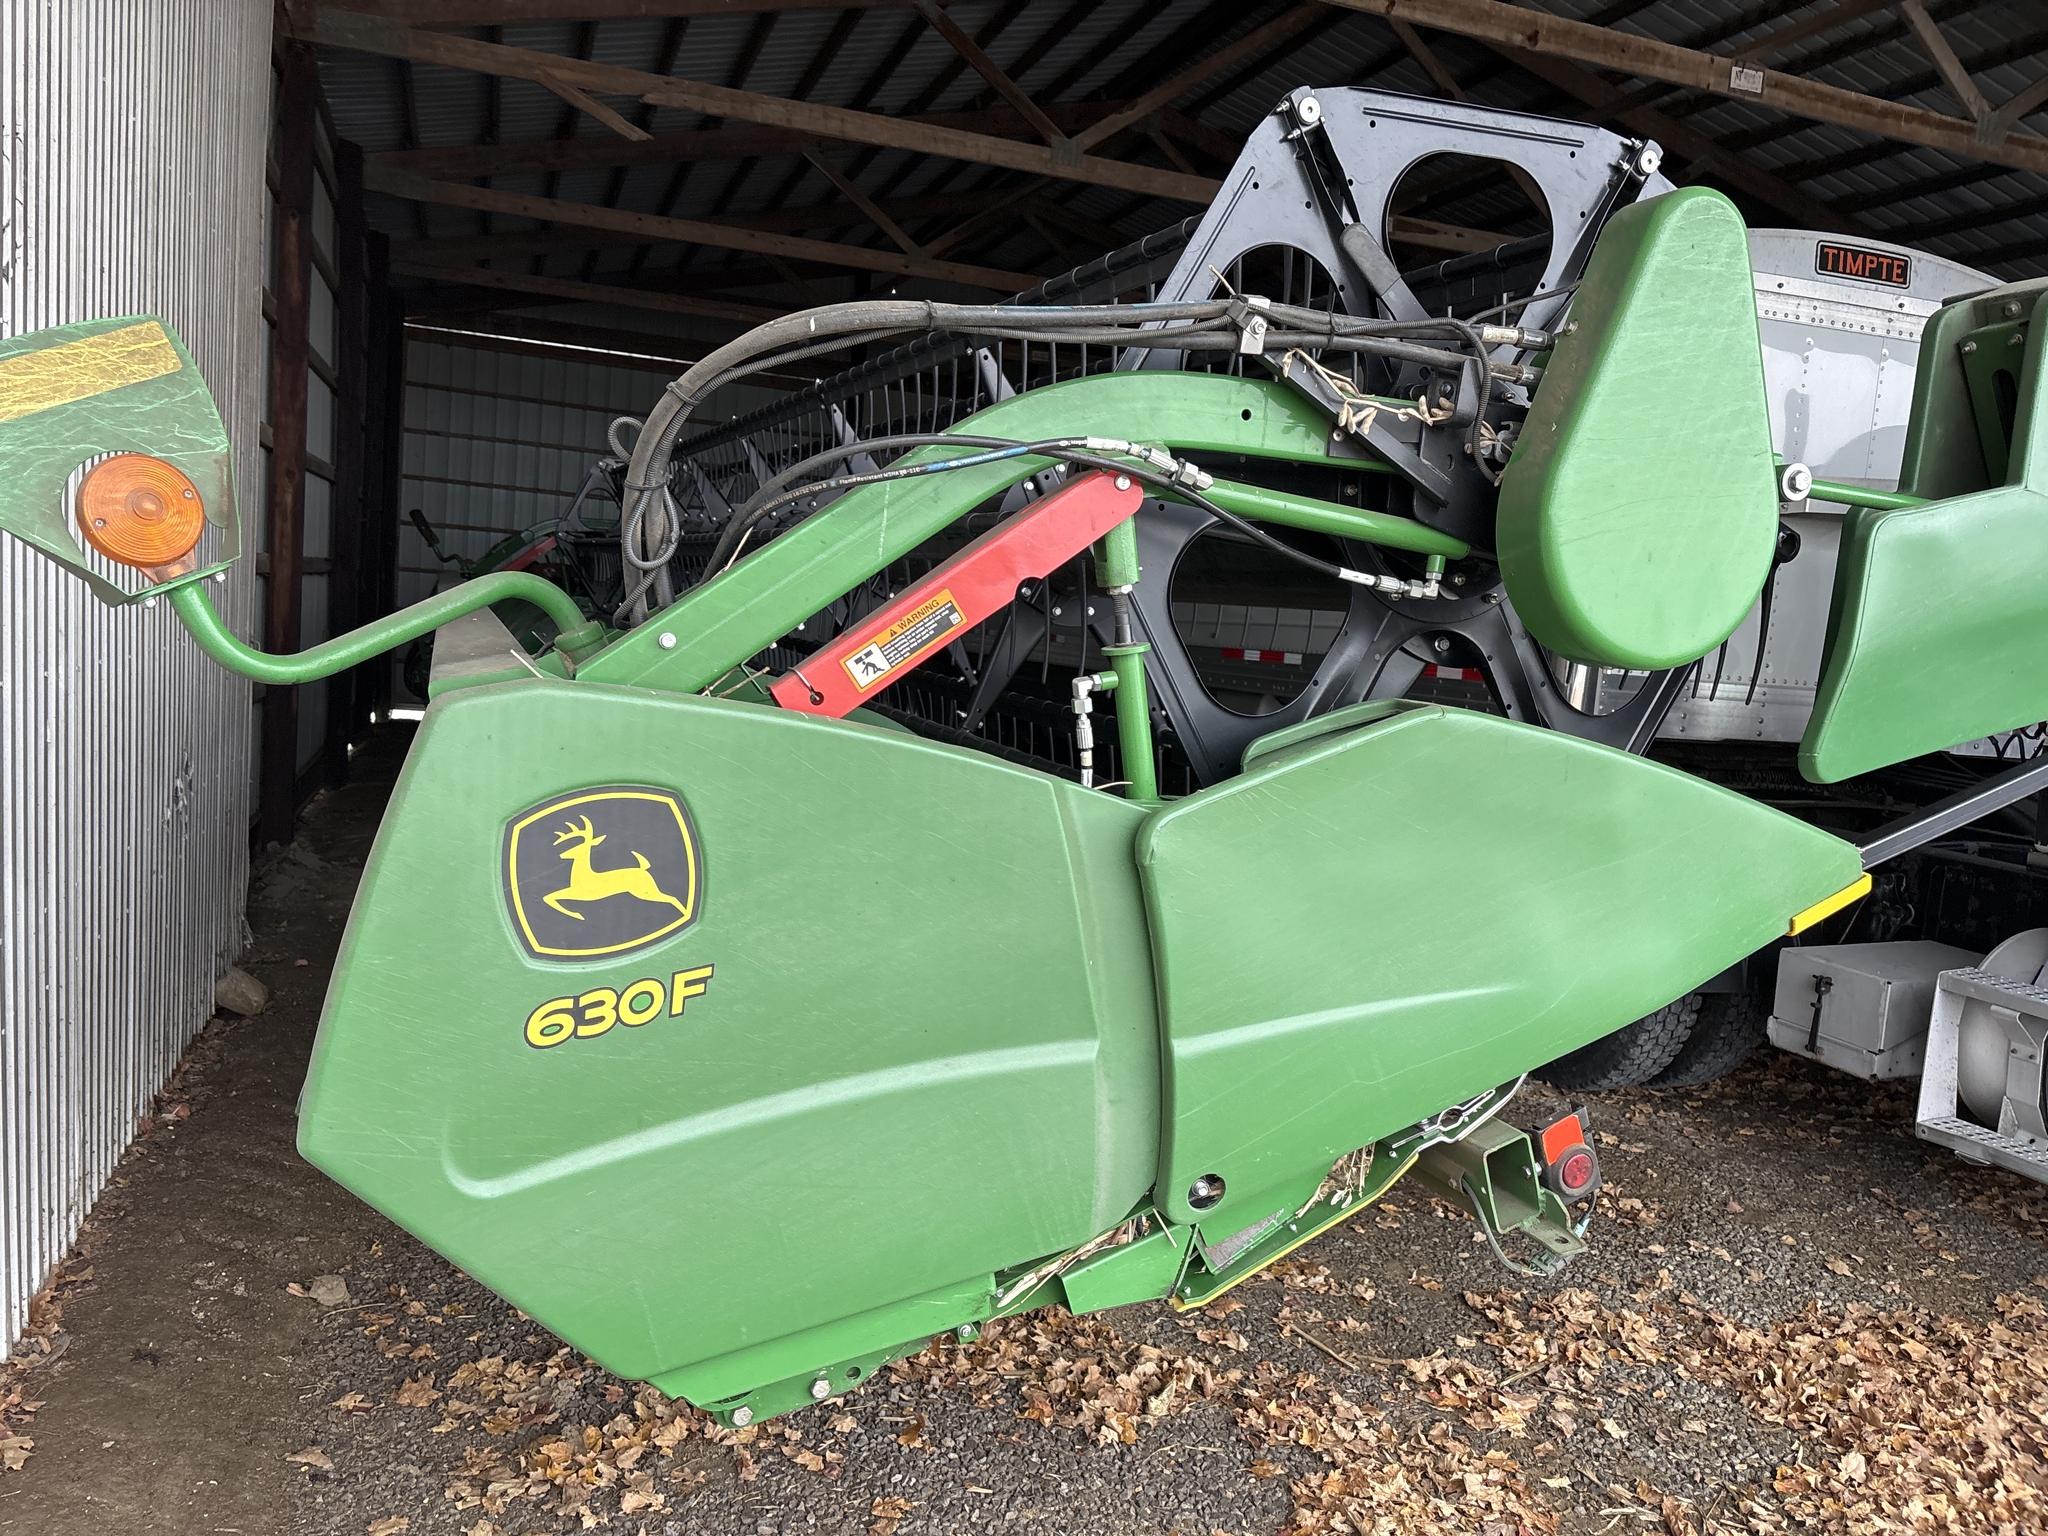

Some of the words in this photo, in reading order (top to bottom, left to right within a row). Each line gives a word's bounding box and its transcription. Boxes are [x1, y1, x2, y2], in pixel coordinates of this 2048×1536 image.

[1824, 247, 1905, 283] TIMPTE
[897, 599, 940, 630] WARNING
[523, 963, 715, 1049] 630F
